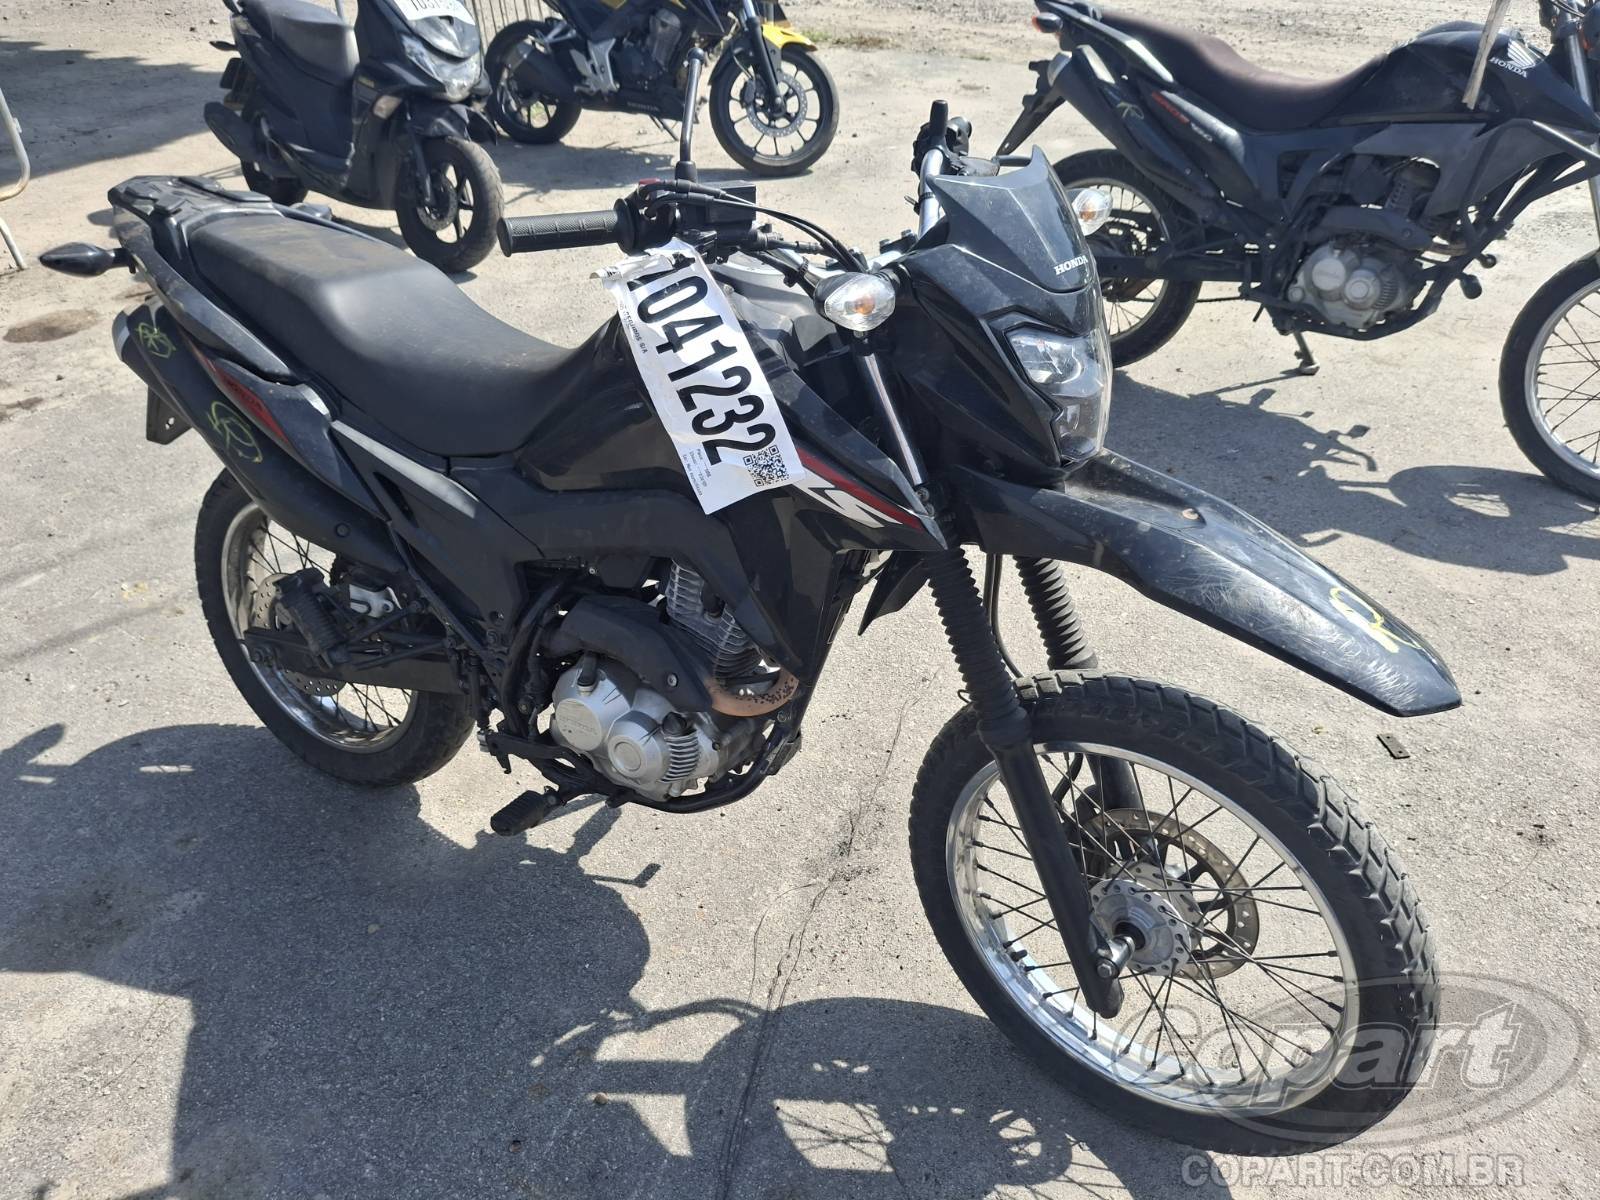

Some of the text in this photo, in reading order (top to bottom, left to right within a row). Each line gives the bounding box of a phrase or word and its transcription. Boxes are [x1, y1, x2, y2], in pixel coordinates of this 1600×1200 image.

[1489, 57, 1527, 78] HONDA
[1053, 255, 1088, 275] HONDA
[627, 252, 777, 466] 1041232
